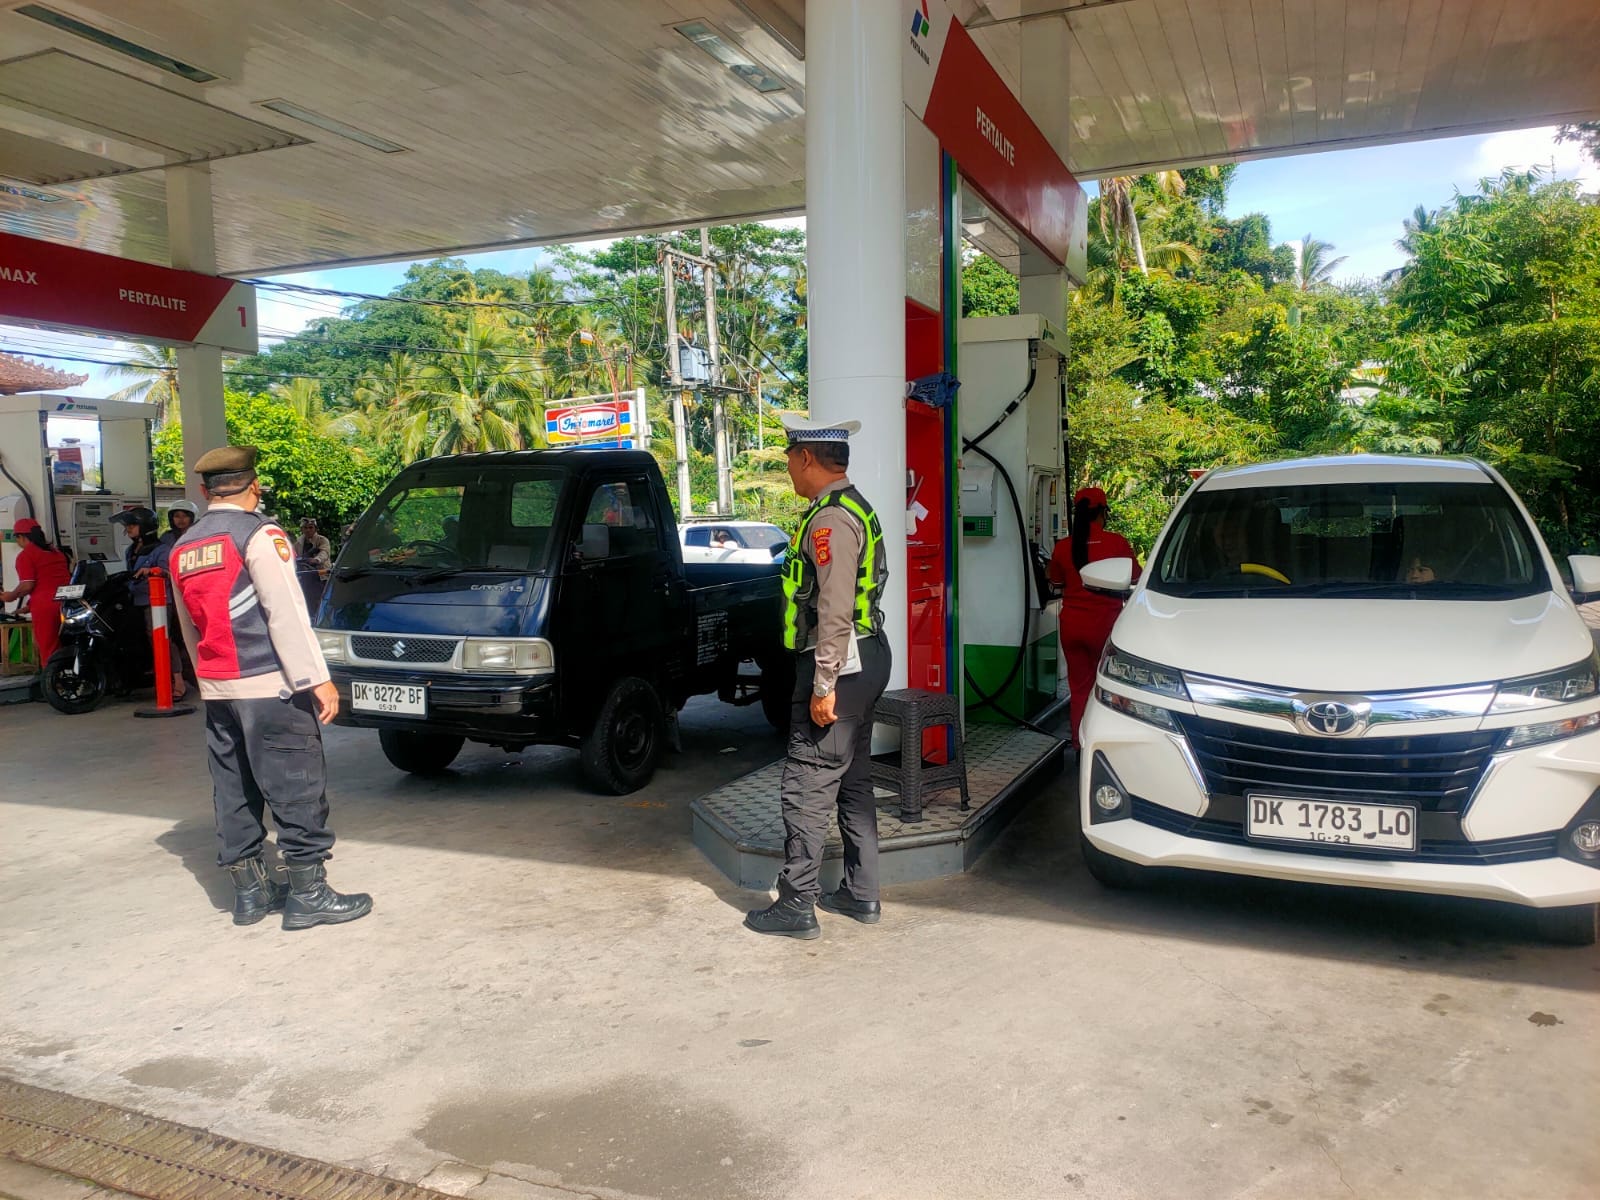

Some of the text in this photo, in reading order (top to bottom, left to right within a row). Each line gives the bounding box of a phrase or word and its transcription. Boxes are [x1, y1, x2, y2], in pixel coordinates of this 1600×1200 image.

[976, 105, 1015, 168] PERTALITE
[118, 288, 187, 312] PERTALITE
[237, 306, 247, 328] 1
[178, 543, 223, 574] POLISI
[353, 684, 423, 705] DK 8272 BF
[1253, 799, 1284, 826] DK
[1298, 803, 1362, 832] 1783
